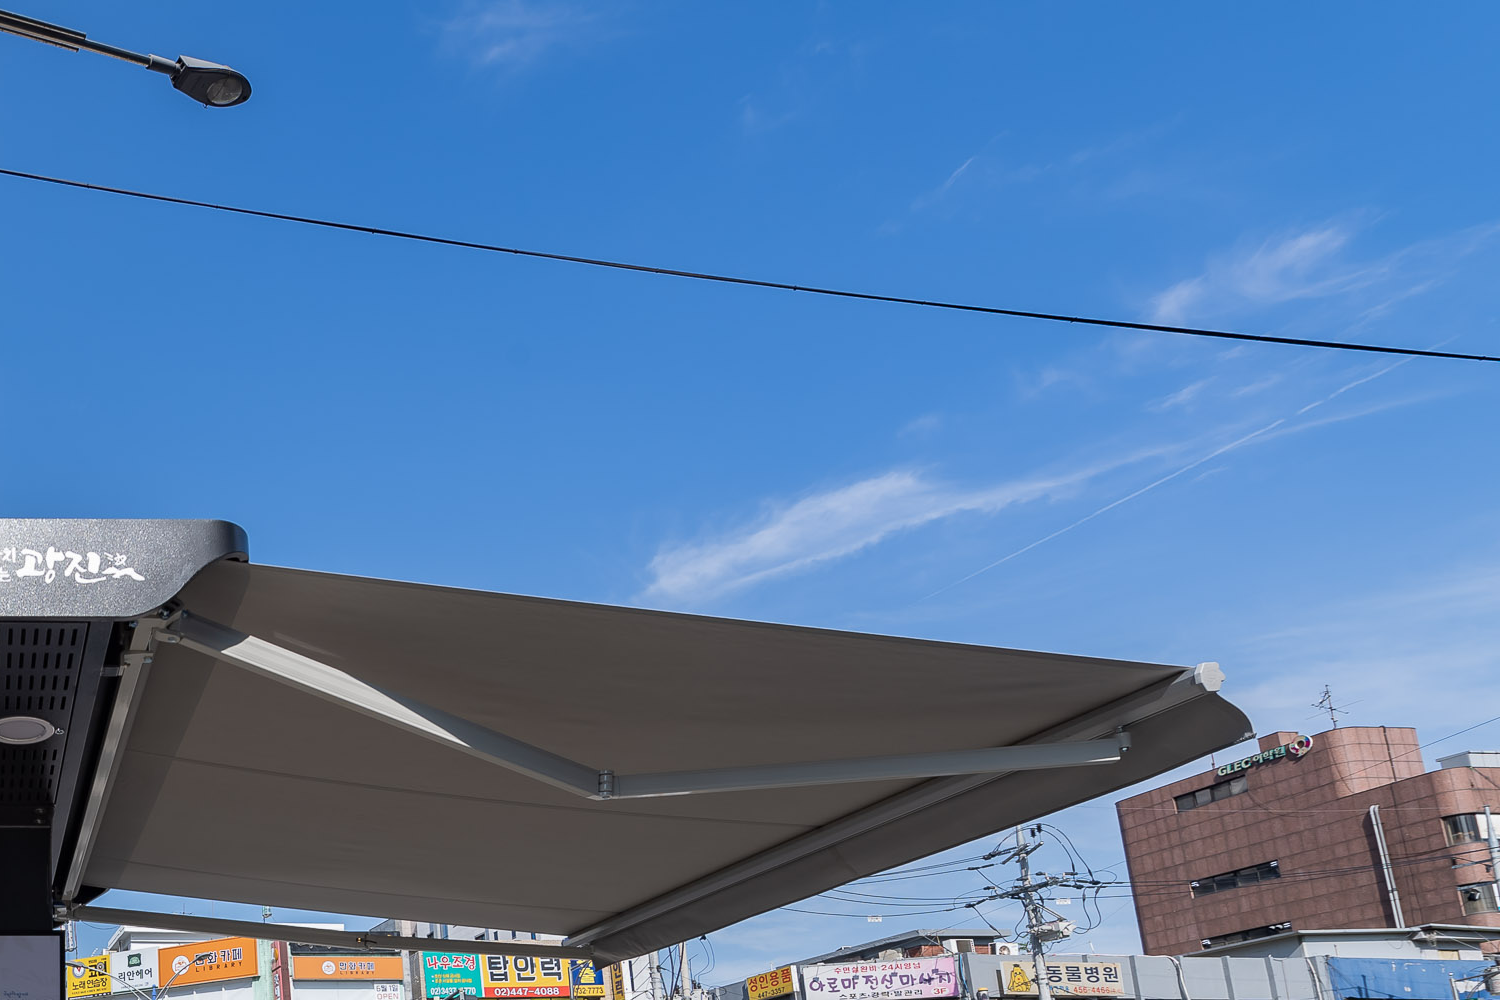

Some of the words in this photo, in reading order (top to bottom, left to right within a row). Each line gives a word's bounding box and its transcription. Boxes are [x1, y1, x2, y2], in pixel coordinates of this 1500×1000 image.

[16, 547, 106, 584] 광진
[1217, 757, 1251, 776] GLEC
[195, 962, 242, 972] LIBRARY
[426, 955, 476, 970] 나우조경
[486, 955, 563, 982] 탑인력
[118, 967, 153, 981] 리안헤어
[748, 968, 791, 993] 성인용품
[1046, 965, 1119, 983] 동물병원
[86, 977, 108, 989] 연습장
[809, 976, 859, 992] 아로마
[1073, 986, 1110, 994] 456-4466
[494, 987, 560, 996] 02)447-4088
[933, 987, 947, 995] 3F
